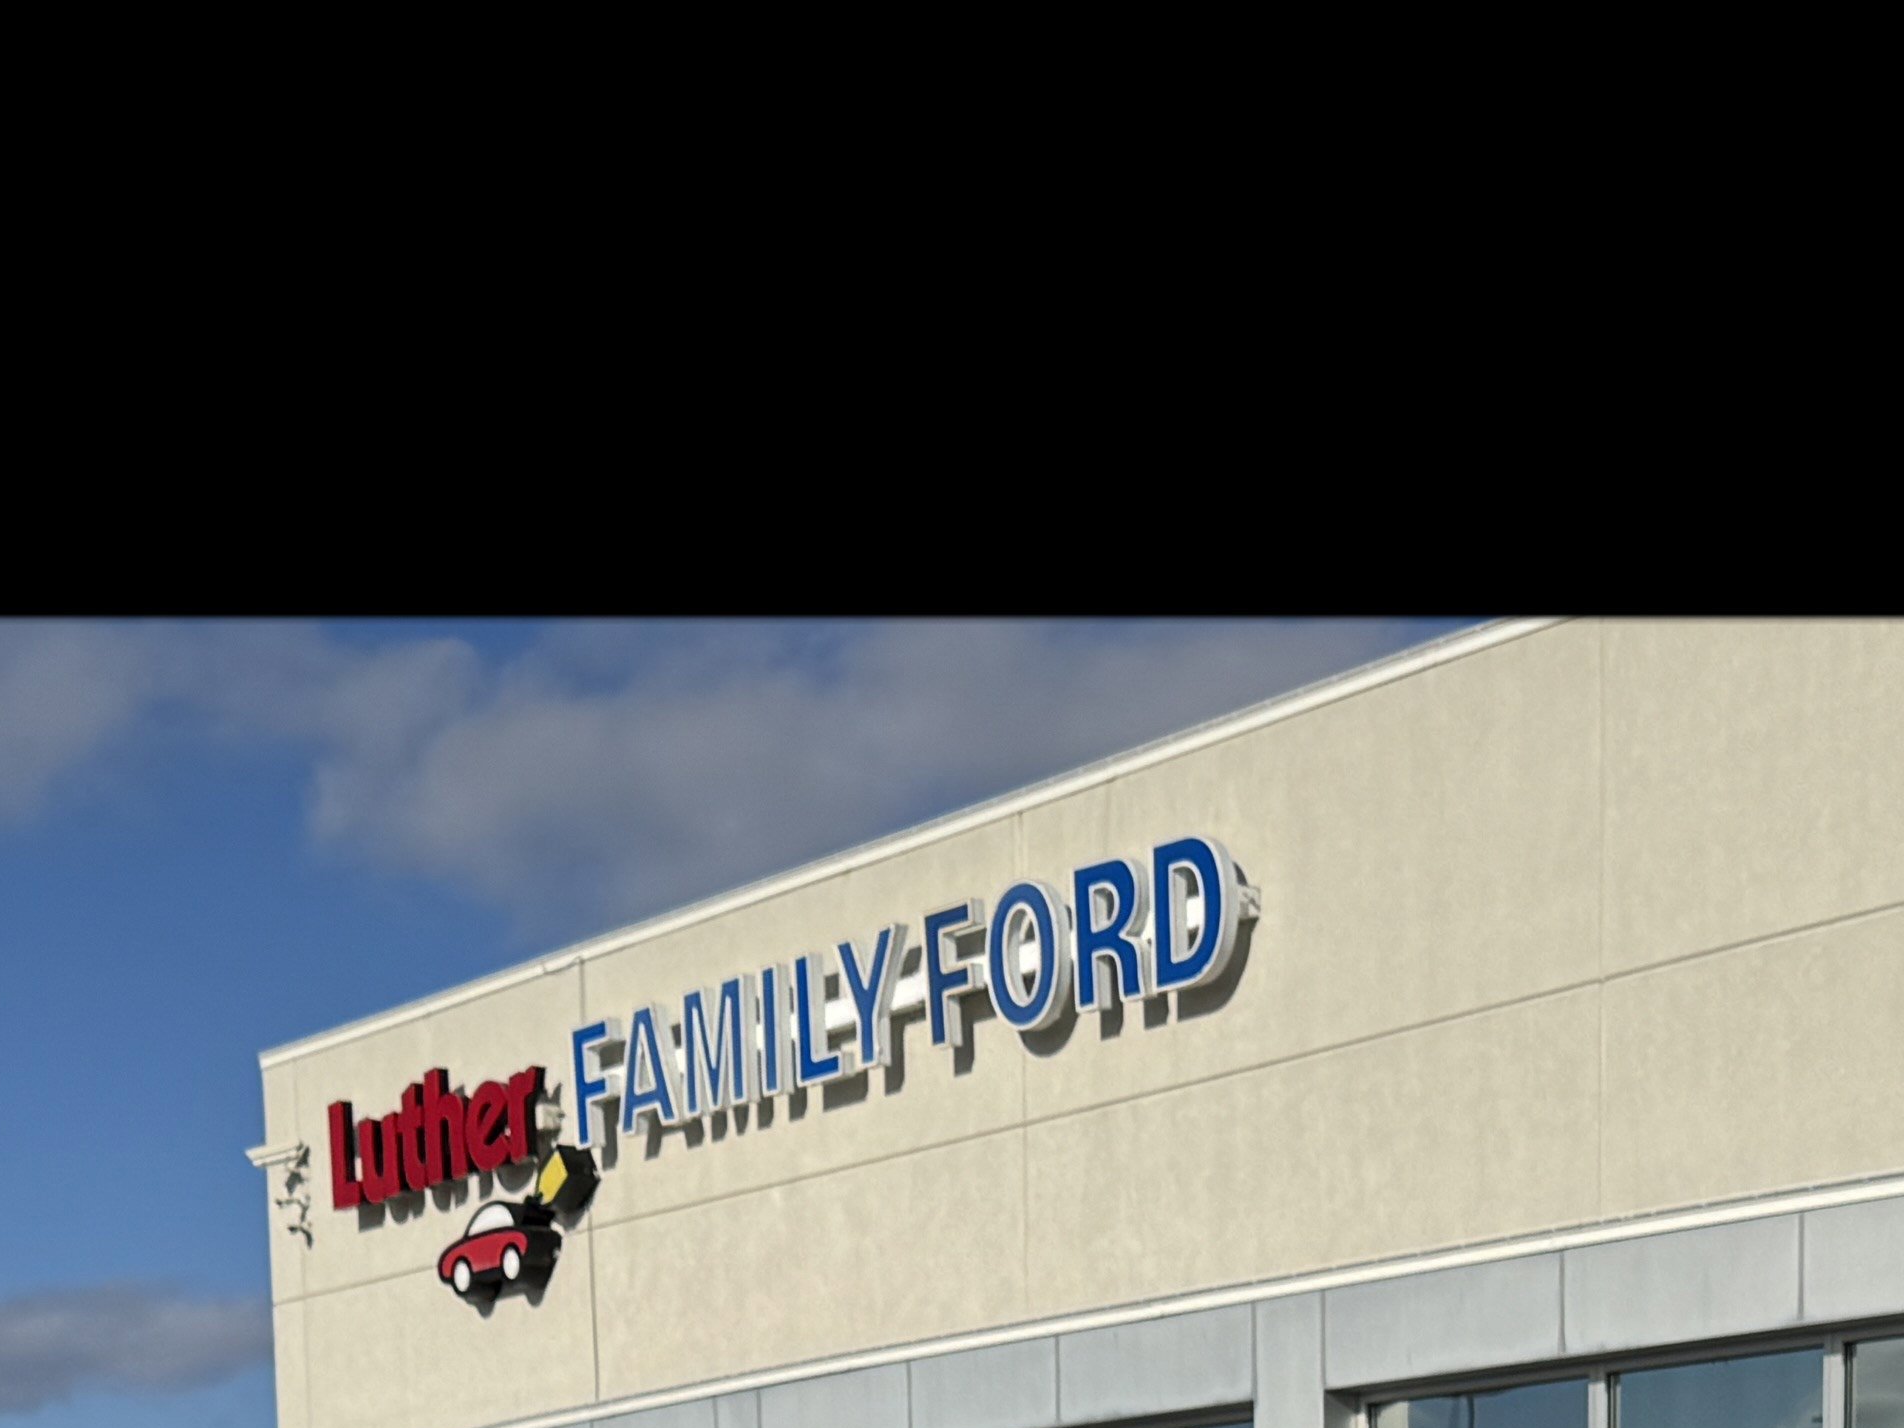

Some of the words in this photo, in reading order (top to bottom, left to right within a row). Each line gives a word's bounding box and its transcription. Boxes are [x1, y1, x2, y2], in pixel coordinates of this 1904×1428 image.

[328, 1065, 545, 1211] Luther
[571, 923, 903, 1150] FAMILY
[921, 833, 1238, 1048] FORD
